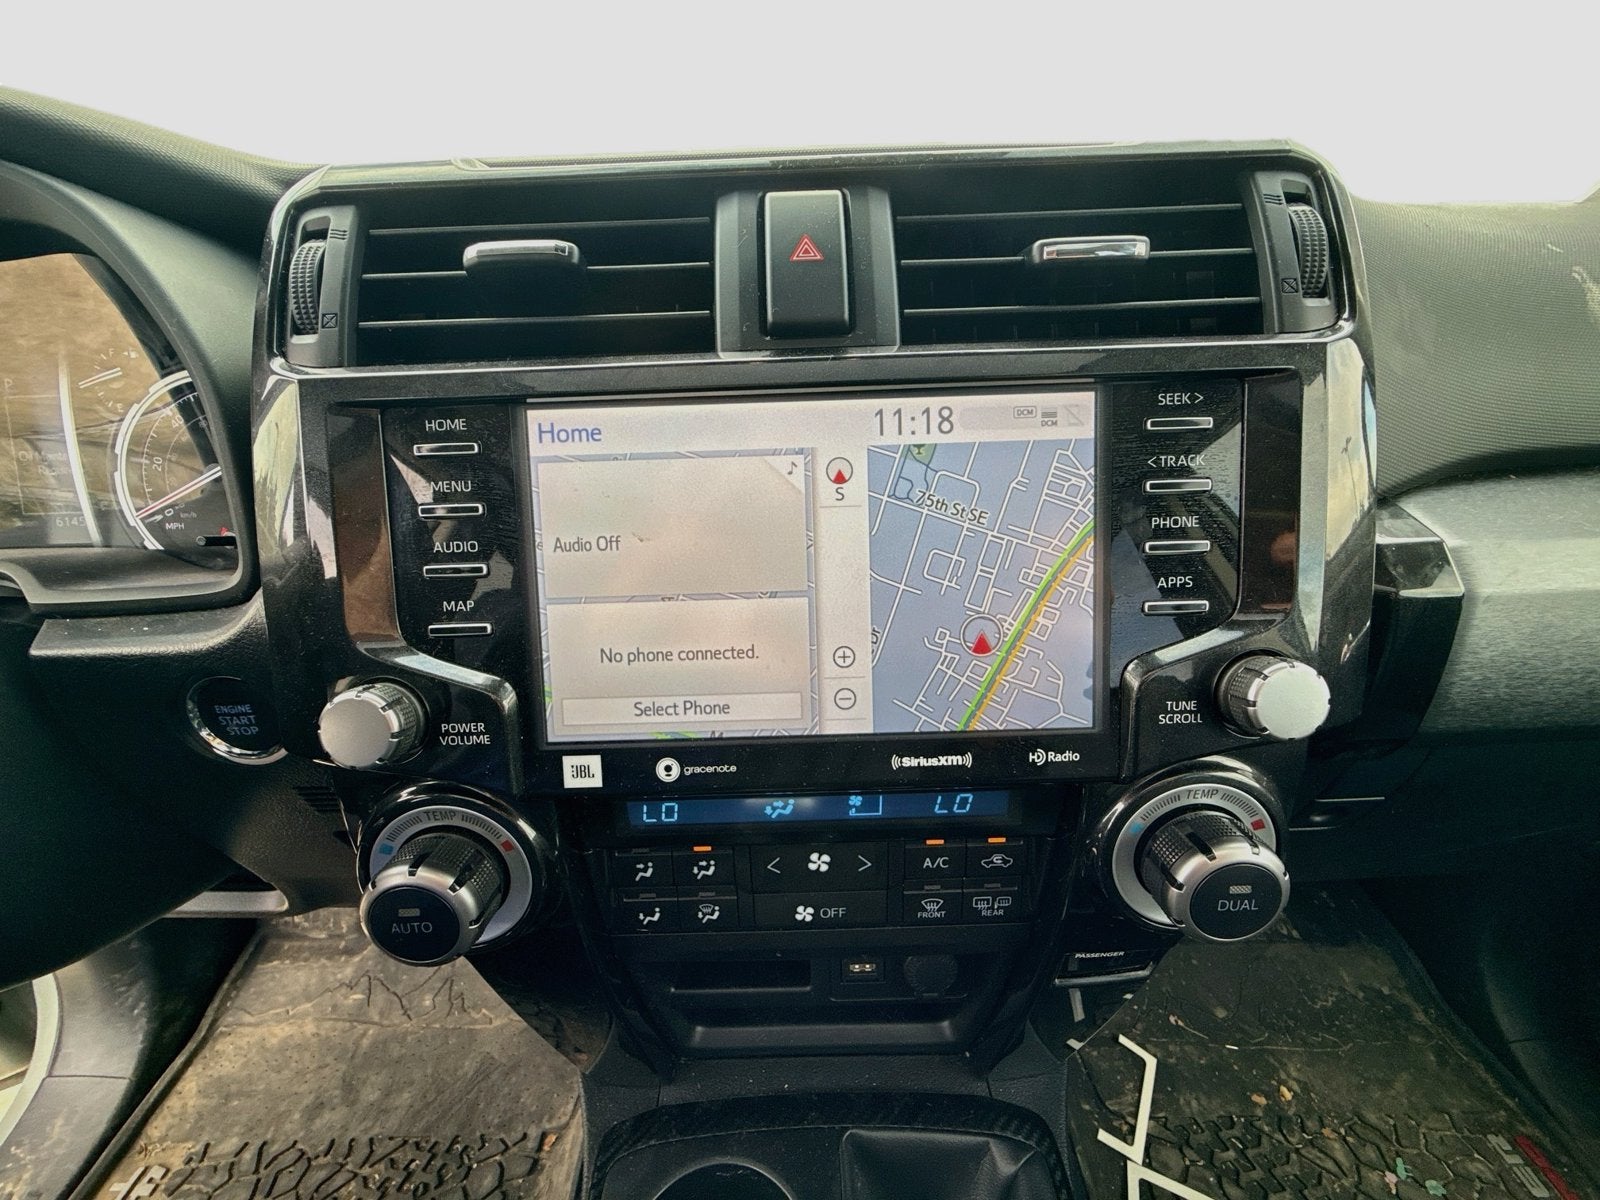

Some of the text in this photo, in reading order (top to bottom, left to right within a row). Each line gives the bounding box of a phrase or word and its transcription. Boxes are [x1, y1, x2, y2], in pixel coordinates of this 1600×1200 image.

[1158, 393, 1191, 405] SEEK
[425, 419, 467, 431] HOME
[874, 406, 954, 436] 11:18
[537, 423, 602, 444] Home
[152, 456, 163, 472] 20
[1160, 454, 1206, 468] TRACK
[430, 480, 472, 493] MENU
[834, 486, 845, 501] S
[916, 490, 989, 526] 75th St SE
[165, 522, 185, 531] MPH
[1151, 515, 1200, 529] PHONE
[433, 540, 479, 554] AUDIO
[553, 536, 593, 553] Audio
[596, 535, 621, 551] Off
[1157, 575, 1194, 589] APPS
[442, 600, 475, 613] MAP
[600, 643, 760, 666] No phone connected.
[214, 704, 253, 714] ENGINE
[633, 698, 731, 718] Select Phone
[1166, 700, 1198, 712] TUNE
[218, 715, 257, 726] START
[1158, 713, 1203, 725] SCROLL
[226, 726, 260, 736] STOP
[441, 722, 486, 734] POWER
[439, 734, 491, 746] VOLUME
[1048, 751, 1080, 763] Radio
[571, 764, 595, 779] JBL
[683, 764, 737, 776] gracenote
[1186, 789, 1219, 801] TEMP
[424, 810, 458, 823] TEMP
[923, 857, 949, 869] A/C
[1217, 900, 1259, 912] DUAL
[820, 907, 847, 919] OFF
[917, 911, 947, 919] FRONT
[981, 909, 1005, 917] REAR
[391, 921, 433, 934] AUTO
[1074, 951, 1126, 960] PASSENGER
